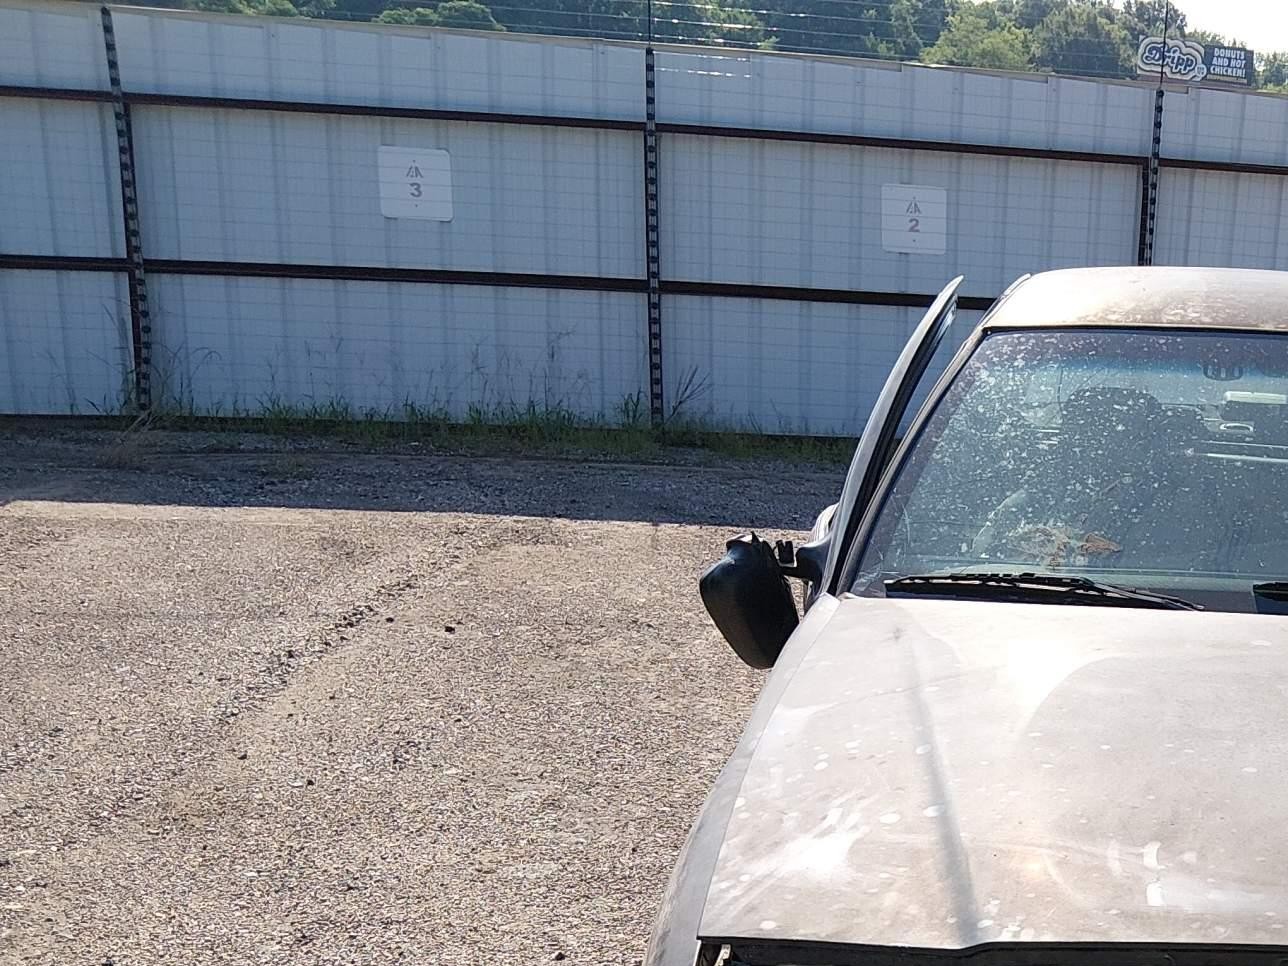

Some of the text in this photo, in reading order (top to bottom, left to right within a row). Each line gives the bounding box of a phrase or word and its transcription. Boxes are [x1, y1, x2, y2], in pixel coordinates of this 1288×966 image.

[1214, 47, 1245, 60] DONUTS
[1211, 56, 1246, 69] AND HOT
[1210, 65, 1246, 78] CHICKEN!
[409, 182, 422, 198] 3
[908, 218, 921, 233] 2
